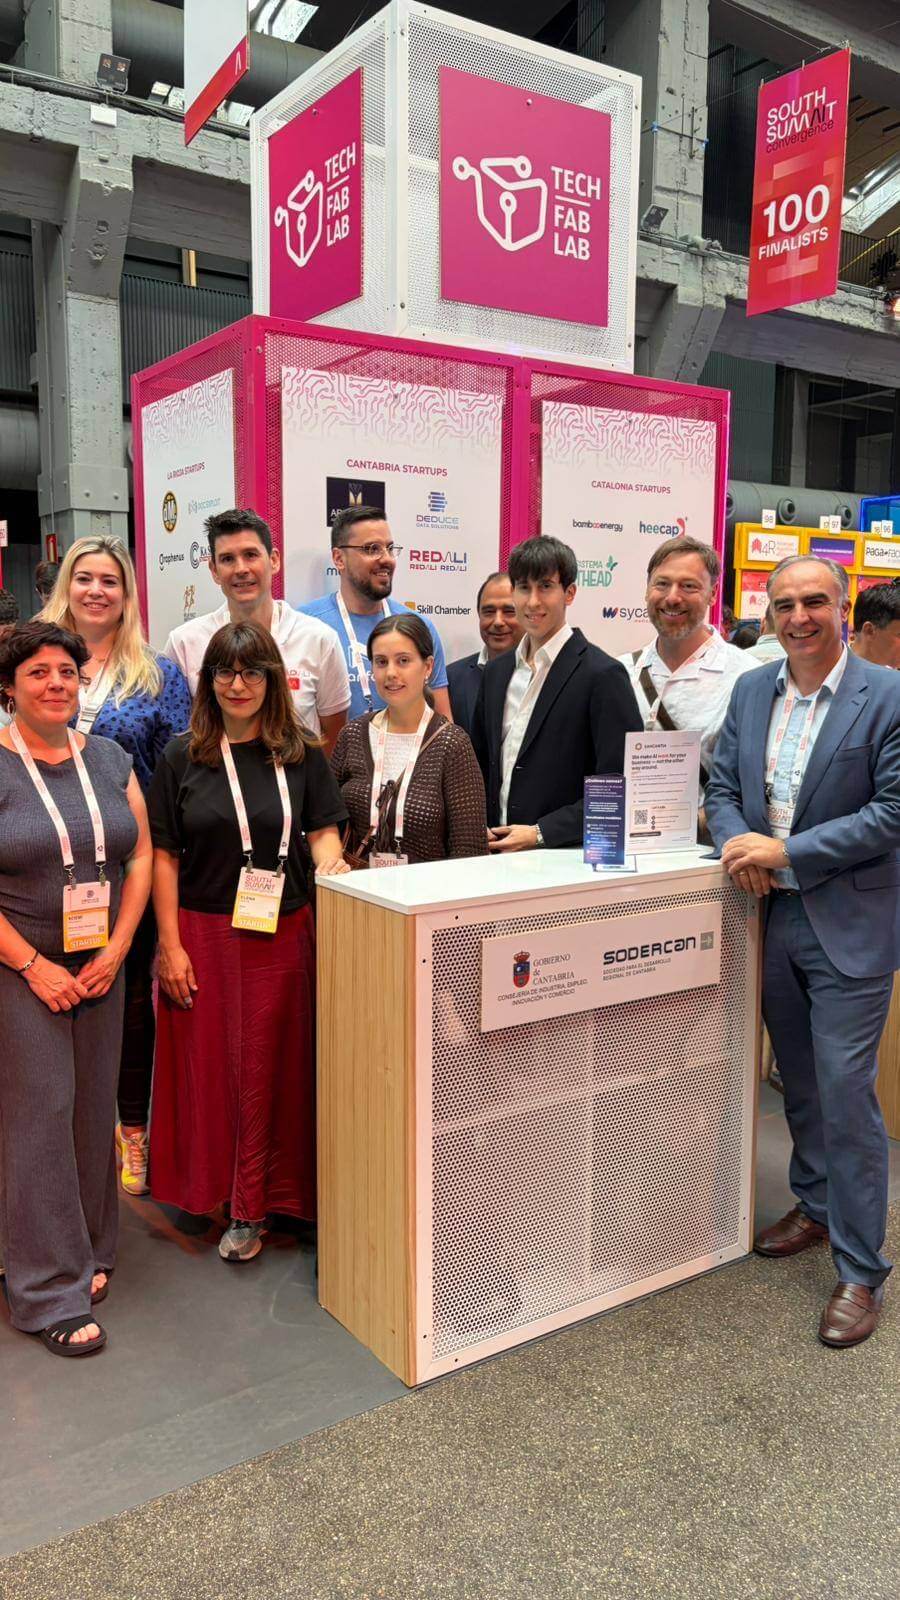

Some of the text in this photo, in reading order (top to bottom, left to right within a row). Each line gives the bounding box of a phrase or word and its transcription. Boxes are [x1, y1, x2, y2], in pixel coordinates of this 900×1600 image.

[767, 86, 827, 126] SOUTH
[766, 118, 835, 154] convergence
[325, 142, 356, 183] TECH
[551, 166, 601, 201] TECH
[326, 186, 350, 217] FAB
[763, 184, 831, 238] 100
[553, 204, 590, 234] FAB
[326, 216, 350, 248] LAB
[758, 226, 829, 261] FINALISTS
[553, 233, 590, 261] LAB
[346, 459, 448, 477] CANTABRIA STARTUPS
[591, 480, 671, 494] CATALONIA STARTUPS
[416, 514, 459, 525] DEDUCE
[639, 521, 679, 537] heecap
[417, 604, 471, 615] Skill Chamber
[620, 607, 649, 621] syca
[246, 875, 273, 884] SOUTH
[533, 953, 571, 967] GOBIERNO
[632, 966, 656, 975] CANTABRIA
[532, 971, 575, 986] CANTABRIA
